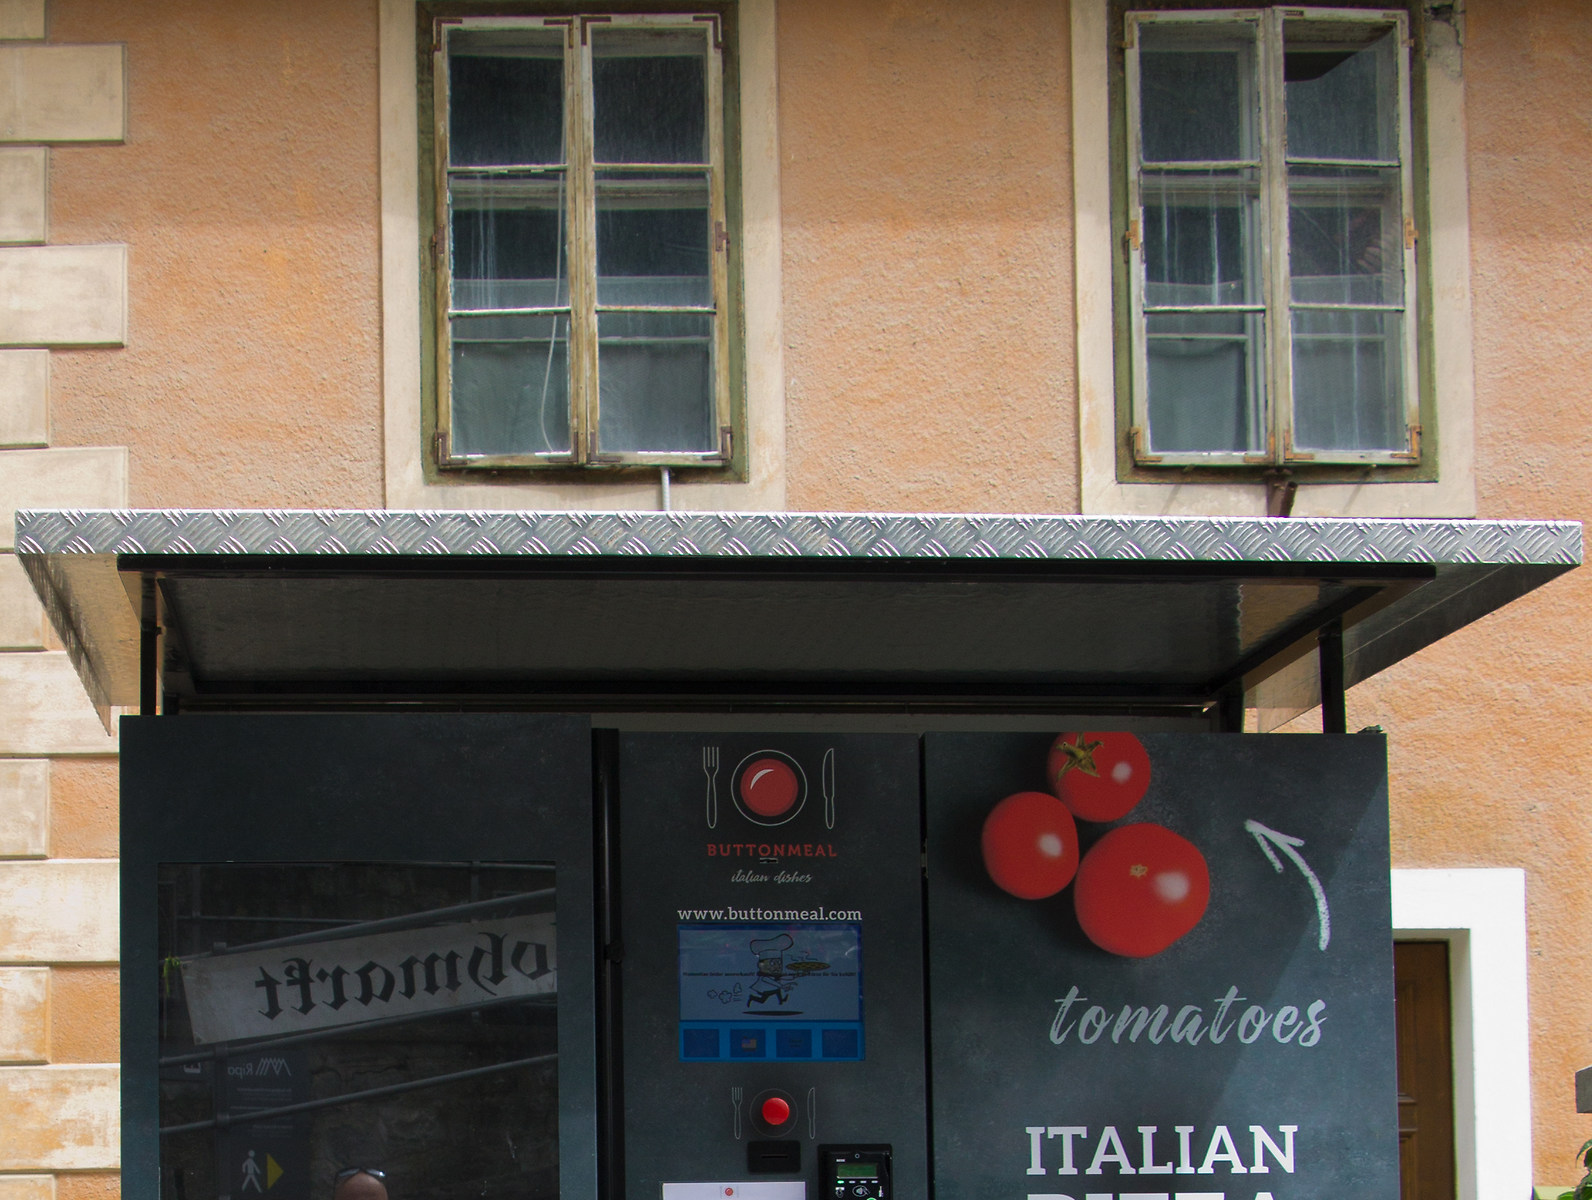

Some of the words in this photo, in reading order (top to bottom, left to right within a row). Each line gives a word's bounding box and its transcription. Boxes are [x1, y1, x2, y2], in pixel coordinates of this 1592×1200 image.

[707, 844, 838, 857] BUTTONMEAL
[731, 868, 769, 883] italian
[773, 869, 813, 883] dishes
[677, 907, 863, 921] www.buttonmeal.com
[1049, 985, 1328, 1047] tomatoes
[1025, 1125, 1299, 1176] ITALIAN
